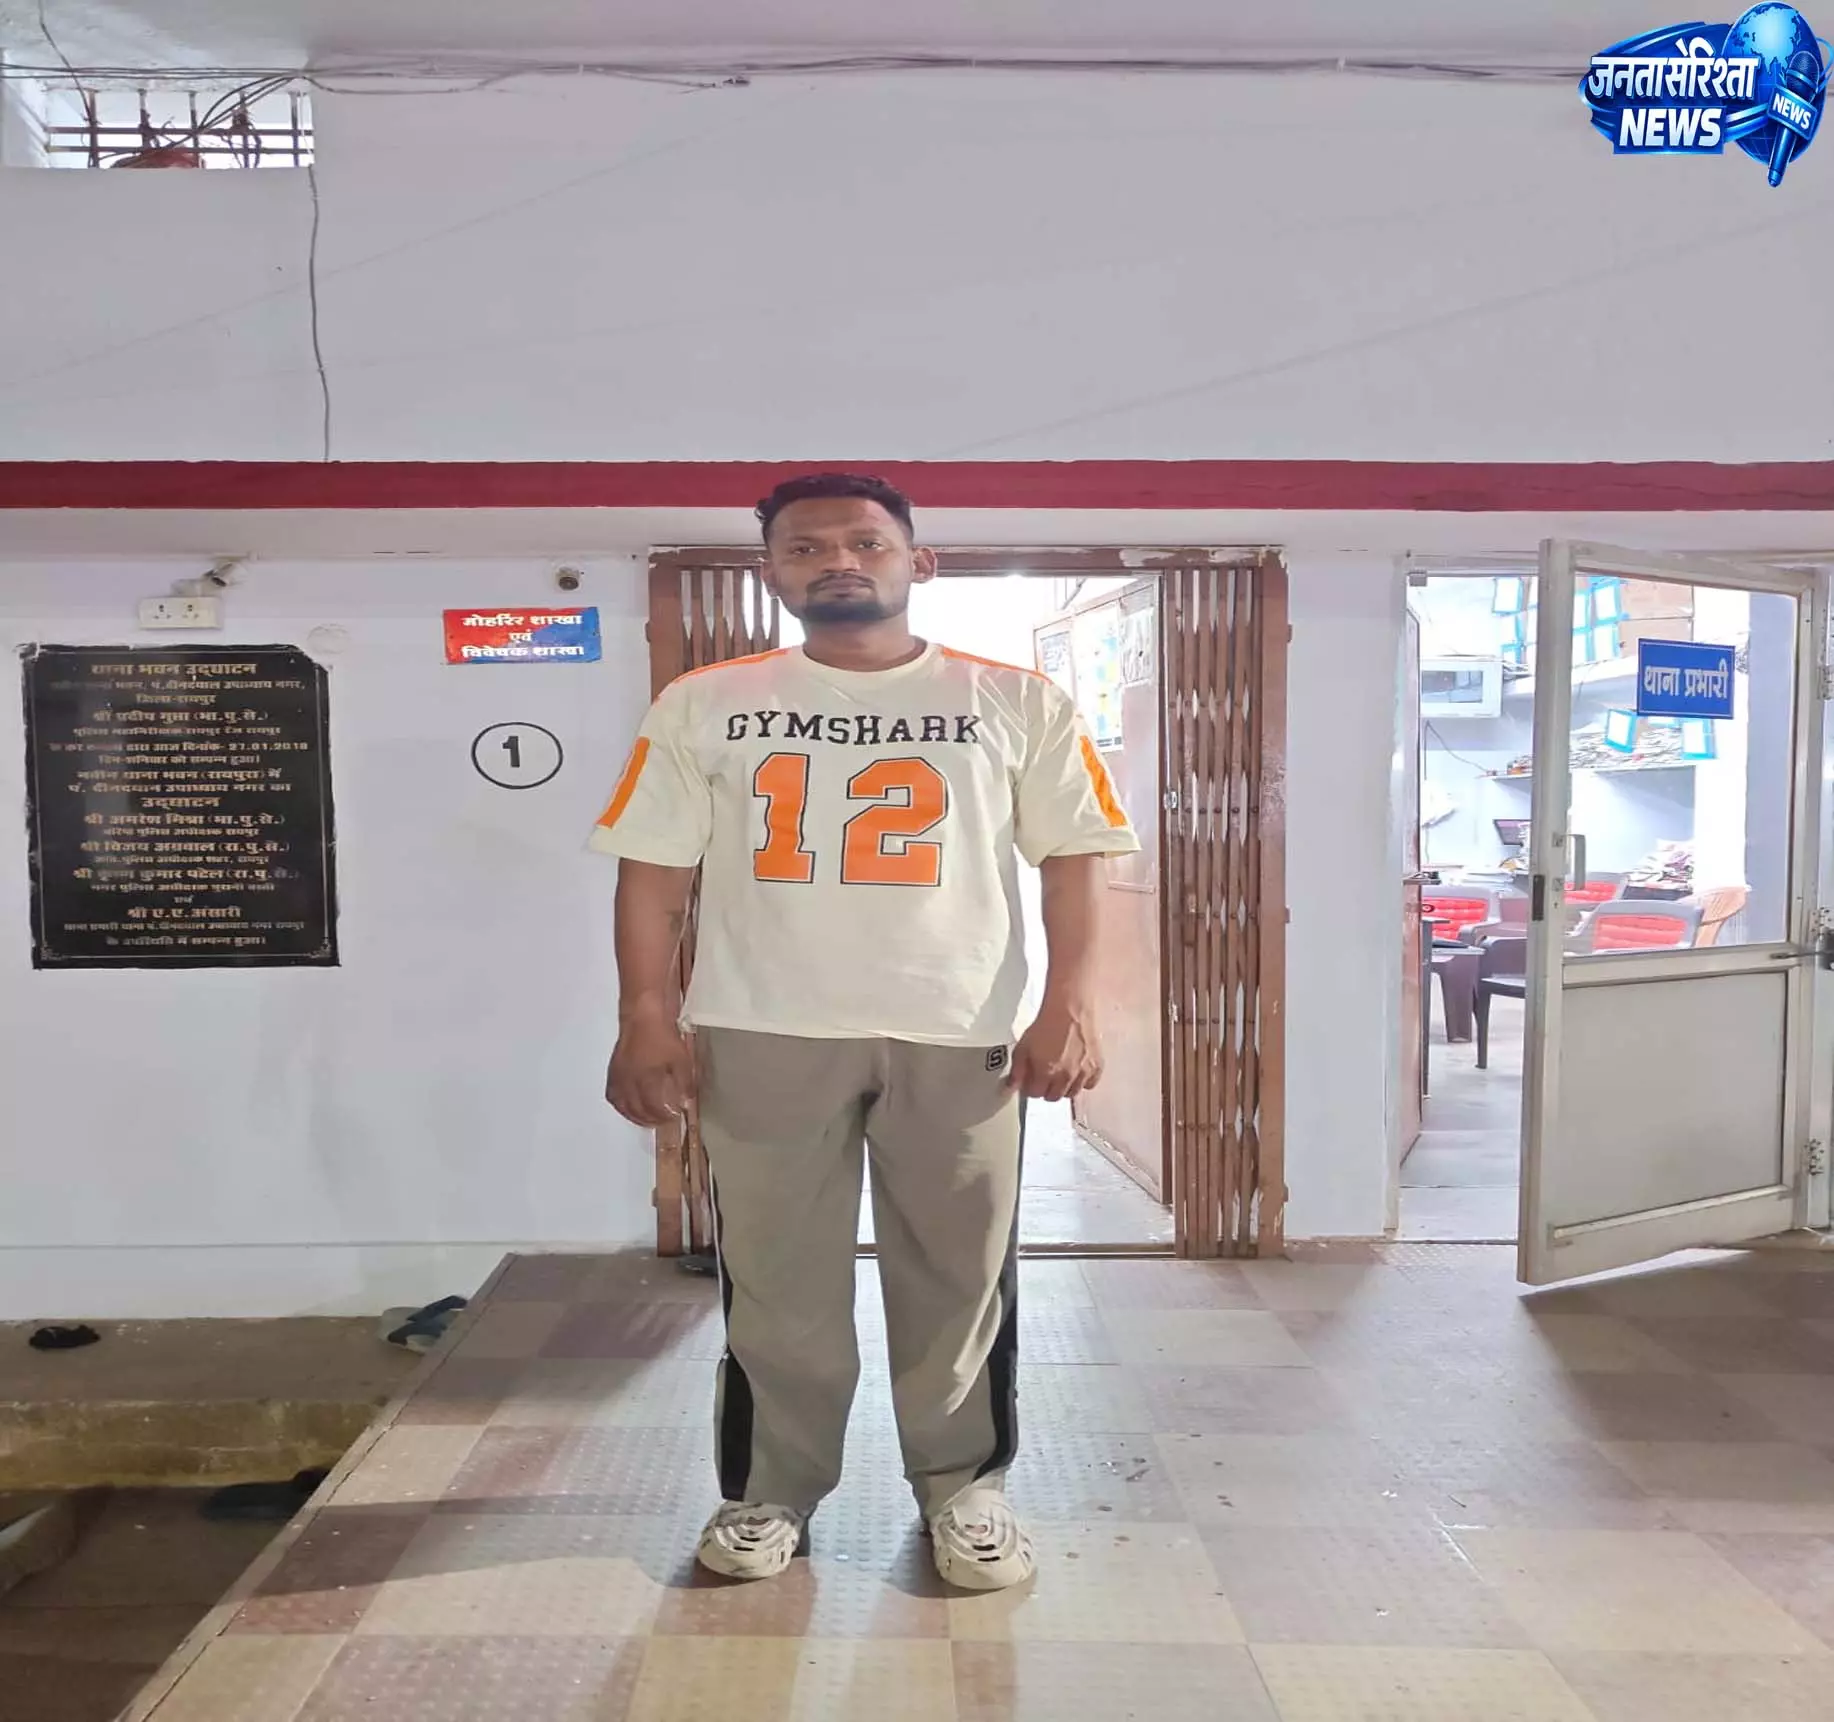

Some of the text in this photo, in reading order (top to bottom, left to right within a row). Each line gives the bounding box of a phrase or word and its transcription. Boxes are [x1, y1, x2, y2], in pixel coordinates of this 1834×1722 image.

[509, 629, 532, 643] एवं
[530, 615, 582, 625] शाखा
[533, 646, 584, 656] शाखा
[1643, 658, 1729, 700] थाना प्रभारी
[727, 711, 982, 745] GYMSHARK
[502, 735, 520, 768] 1
[753, 752, 949, 887] 12
